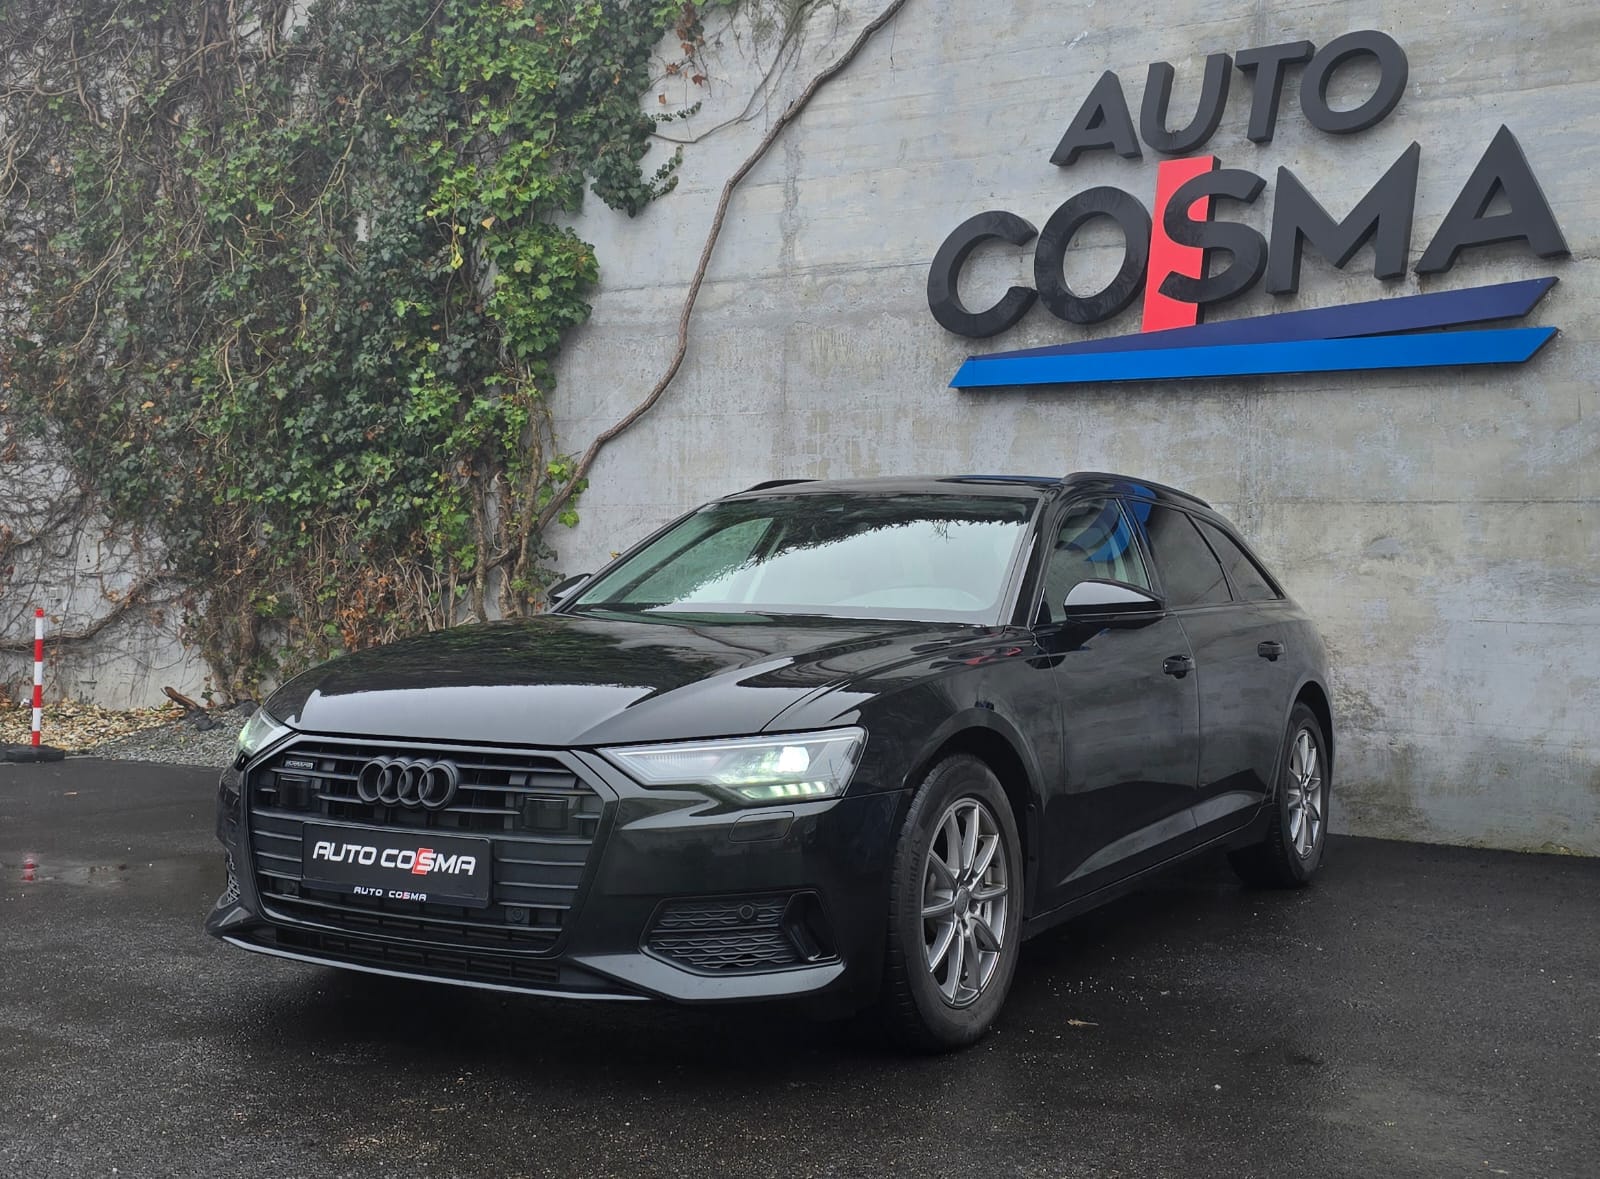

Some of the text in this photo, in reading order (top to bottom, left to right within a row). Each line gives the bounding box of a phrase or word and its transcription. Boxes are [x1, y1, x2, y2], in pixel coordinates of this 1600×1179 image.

[1049, 29, 1409, 168] AUTO
[926, 123, 1571, 338] COSMA
[312, 841, 476, 876] AUTO COSMA
[353, 886, 427, 902] AUTO COSMA
